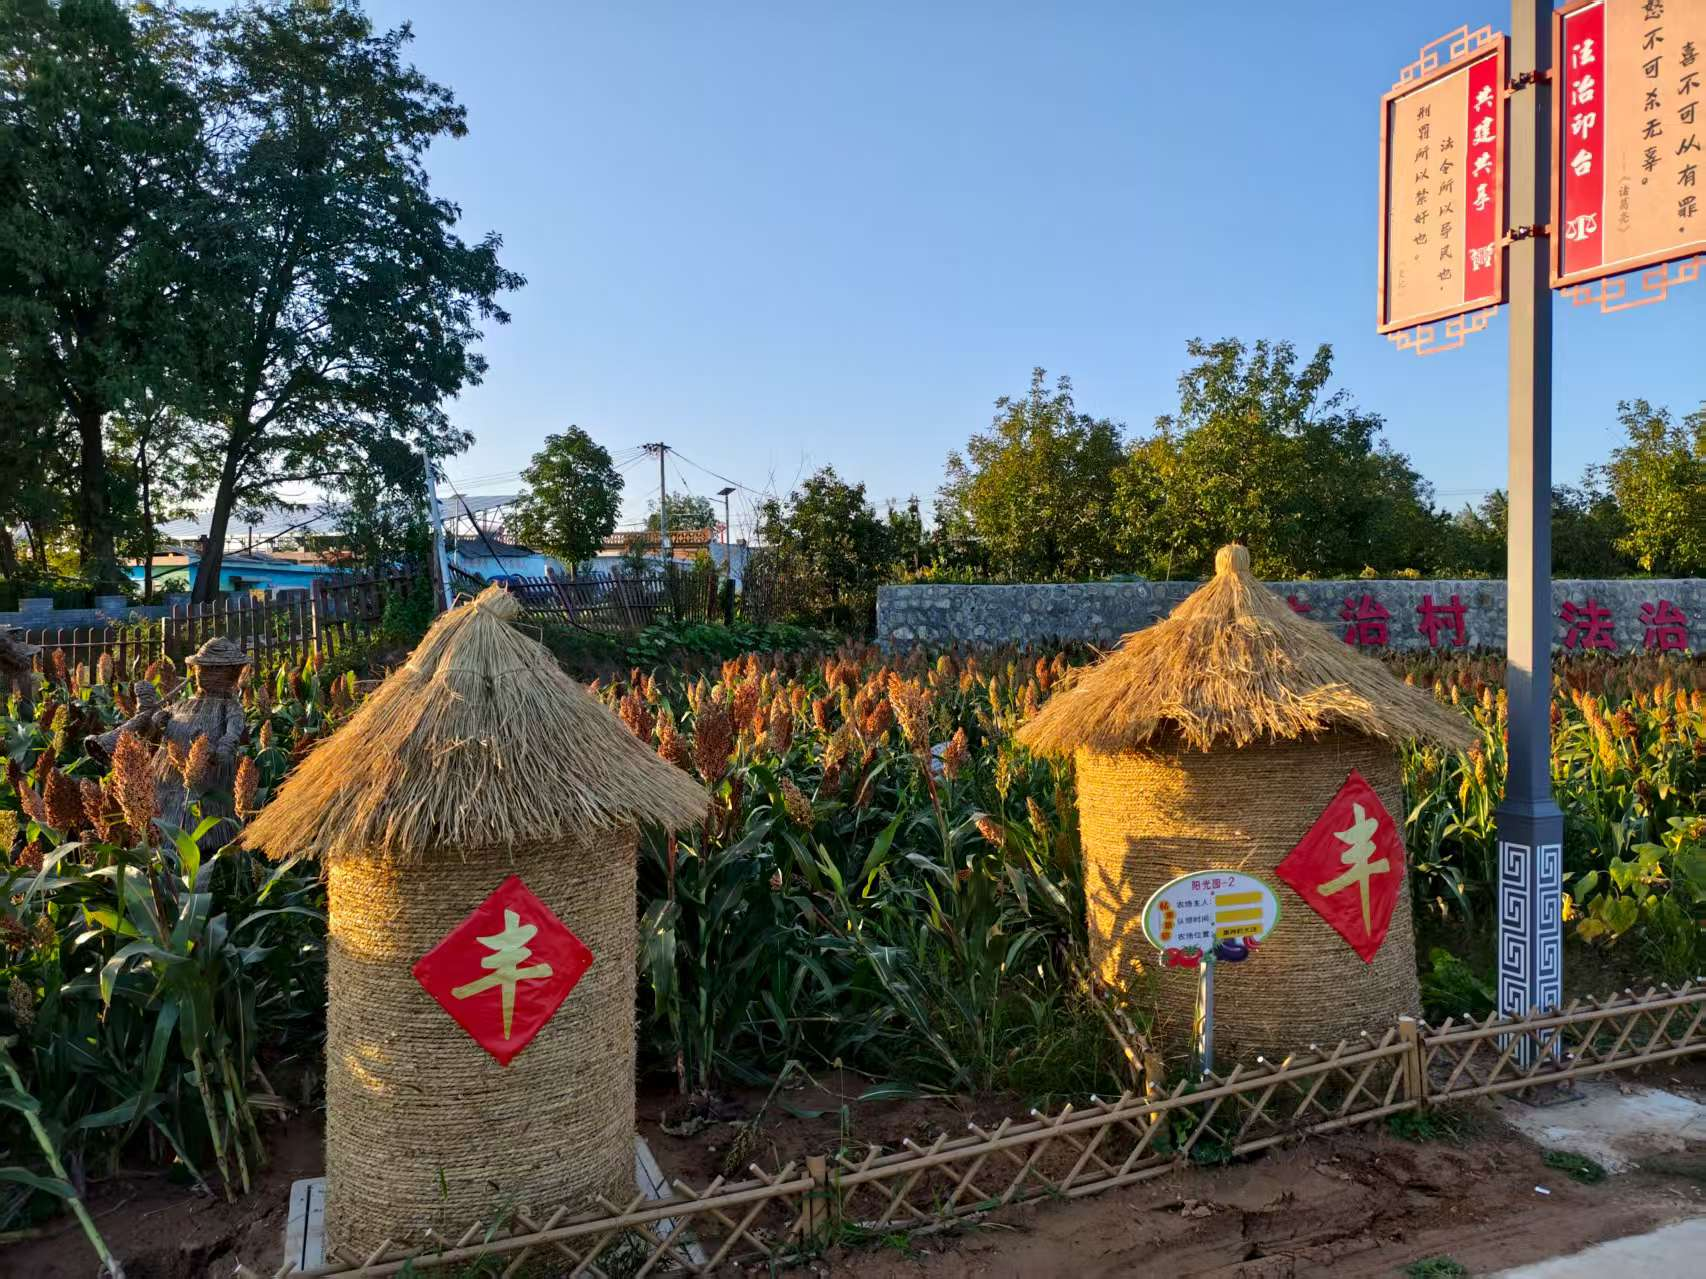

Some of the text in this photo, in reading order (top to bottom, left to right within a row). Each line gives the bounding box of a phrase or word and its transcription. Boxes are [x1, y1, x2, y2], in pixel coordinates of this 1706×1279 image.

[1472, 84, 1497, 212] 共建共享
[1571, 37, 1596, 177] 法治印台
